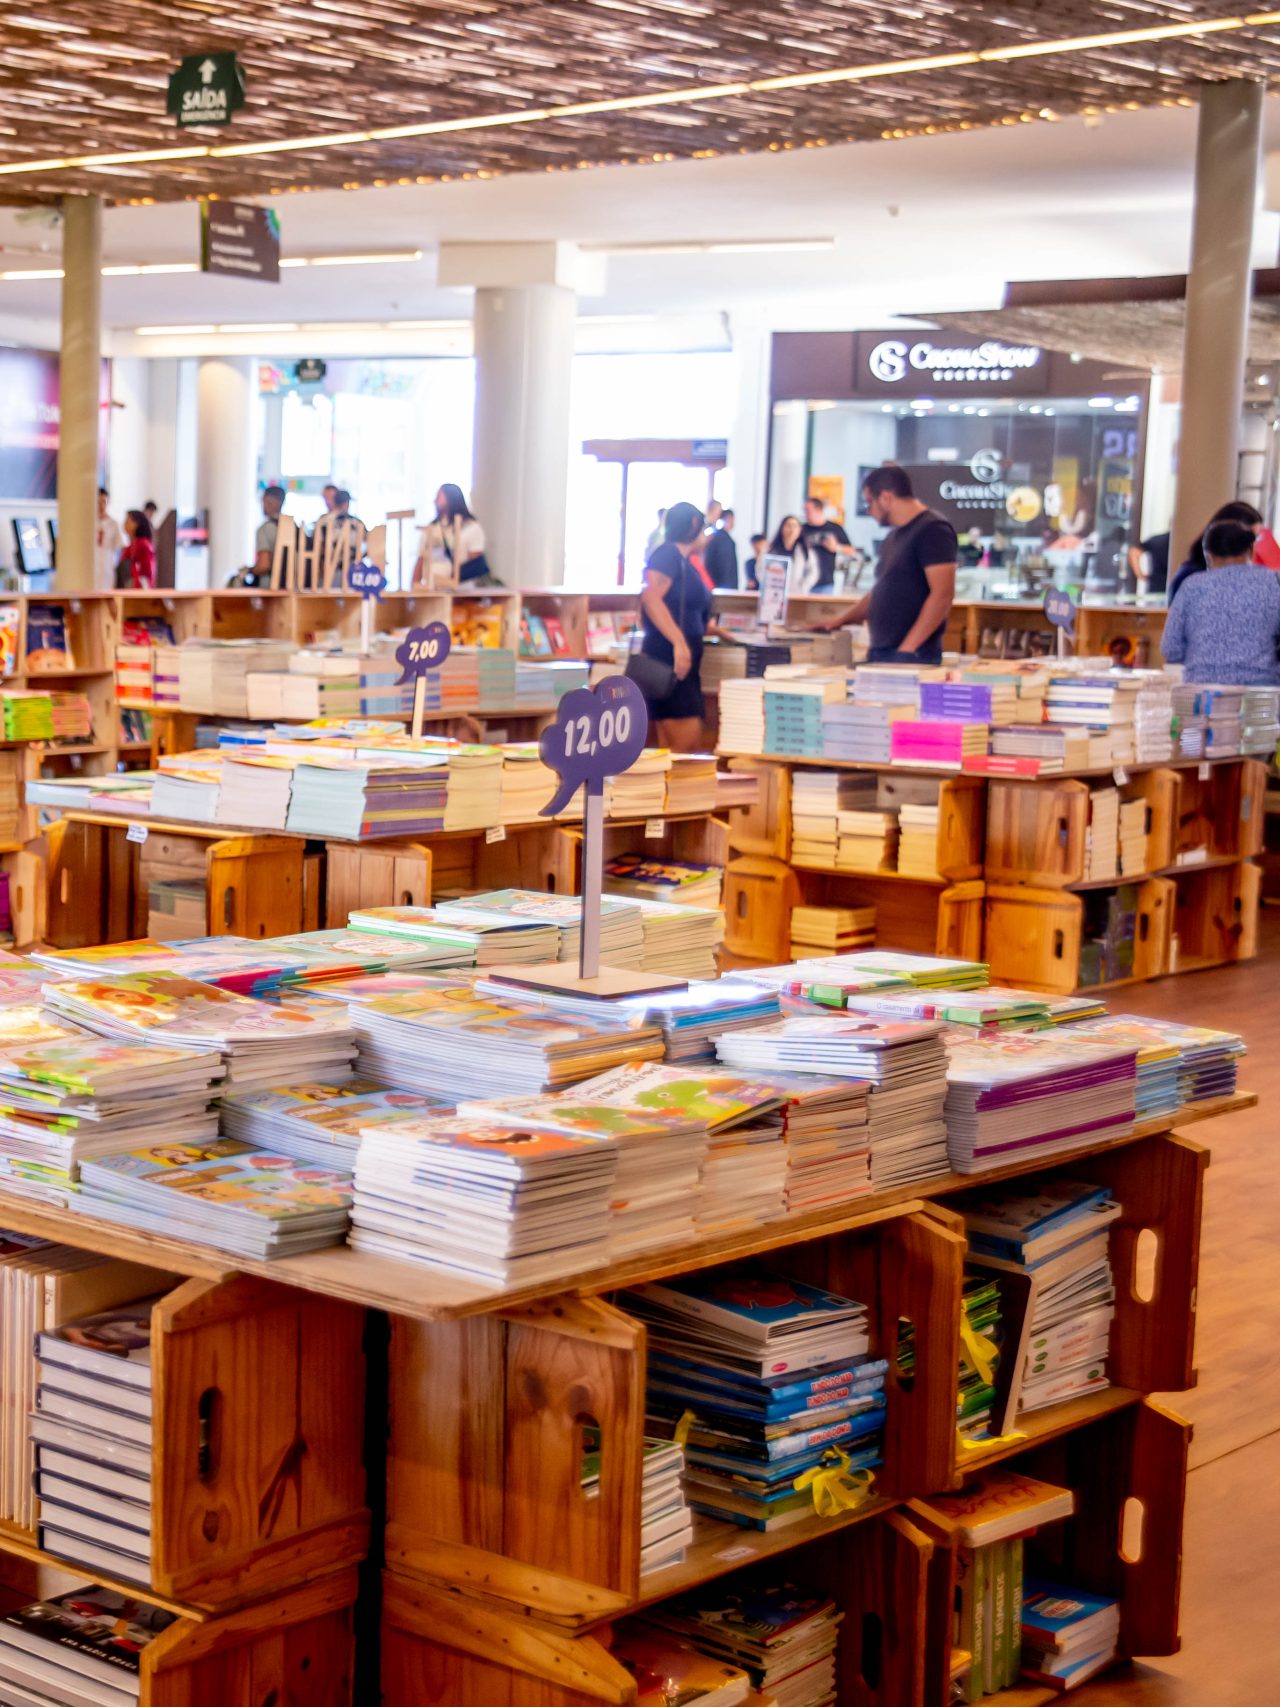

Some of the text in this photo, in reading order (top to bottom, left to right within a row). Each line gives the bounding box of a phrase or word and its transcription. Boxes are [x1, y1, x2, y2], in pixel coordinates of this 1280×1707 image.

[182, 86, 227, 110] SAÍDA
[409, 639, 439, 663] 7,00
[564, 706, 631, 757] 12,00
